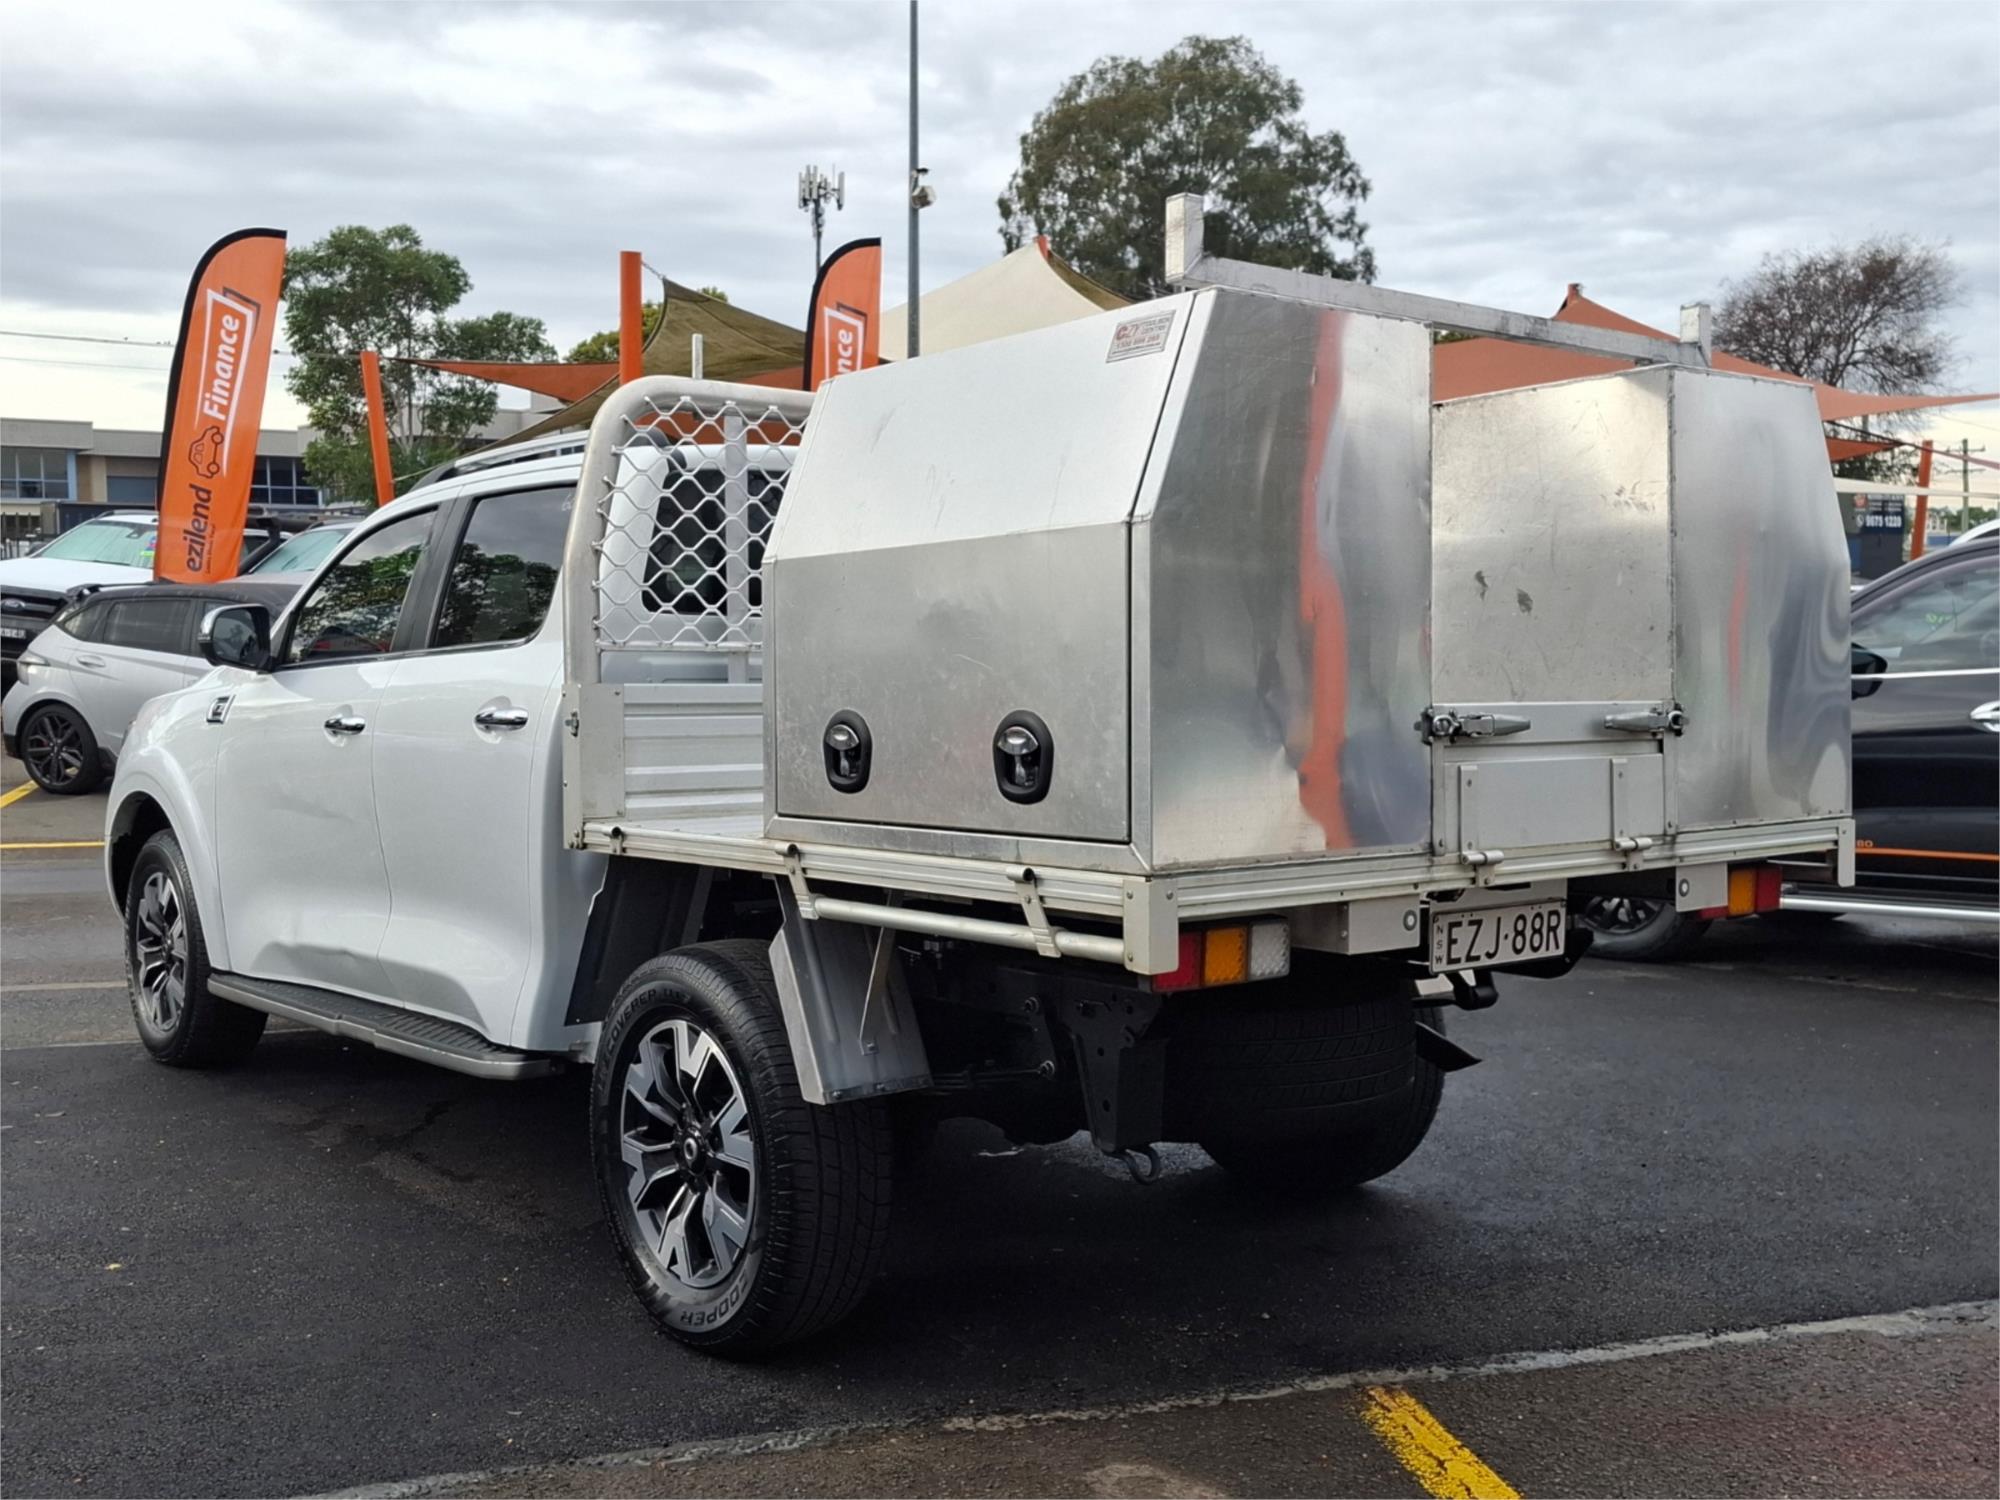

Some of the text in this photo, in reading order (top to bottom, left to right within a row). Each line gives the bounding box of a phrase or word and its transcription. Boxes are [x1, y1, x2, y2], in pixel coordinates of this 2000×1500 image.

[202, 314, 240, 421] Finance
[837, 329, 853, 373] nce
[183, 483, 213, 572] ezilend
